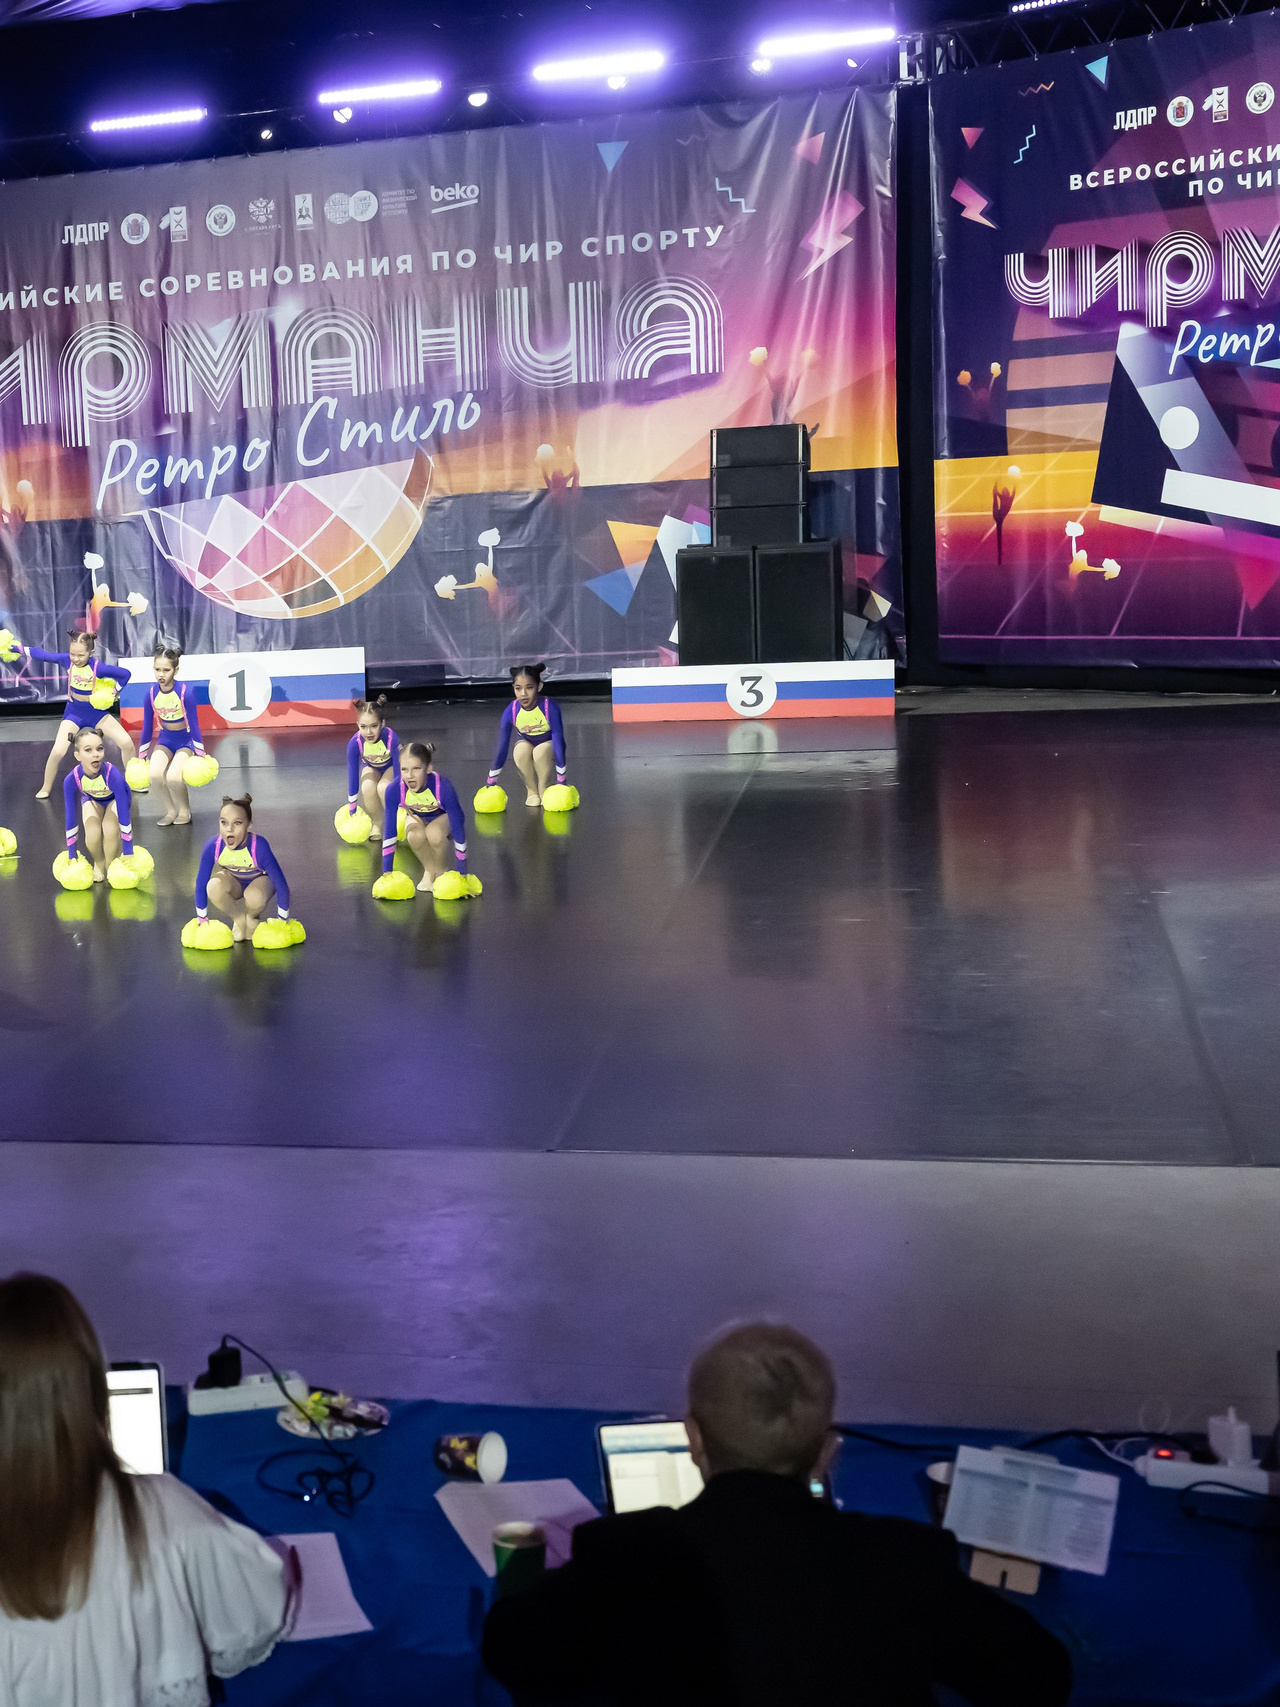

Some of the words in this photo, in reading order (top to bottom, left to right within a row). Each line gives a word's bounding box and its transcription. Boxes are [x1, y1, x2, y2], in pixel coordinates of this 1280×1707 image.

[1113, 106, 1157, 131] ЛДПР
[430, 182, 480, 202] beko
[1188, 177, 1224, 198] ПО
[61, 221, 110, 246] ЛДПР
[139, 254, 414, 298] СОРЕВНОВАНИЯ
[431, 249, 477, 272] ПО
[493, 240, 564, 265] ЧИР
[581, 225, 725, 258] СПОРТУ
[96, 438, 270, 511] Ретро
[296, 392, 481, 468] Стиль
[228, 670, 252, 712] 1
[738, 675, 764, 709] 3
